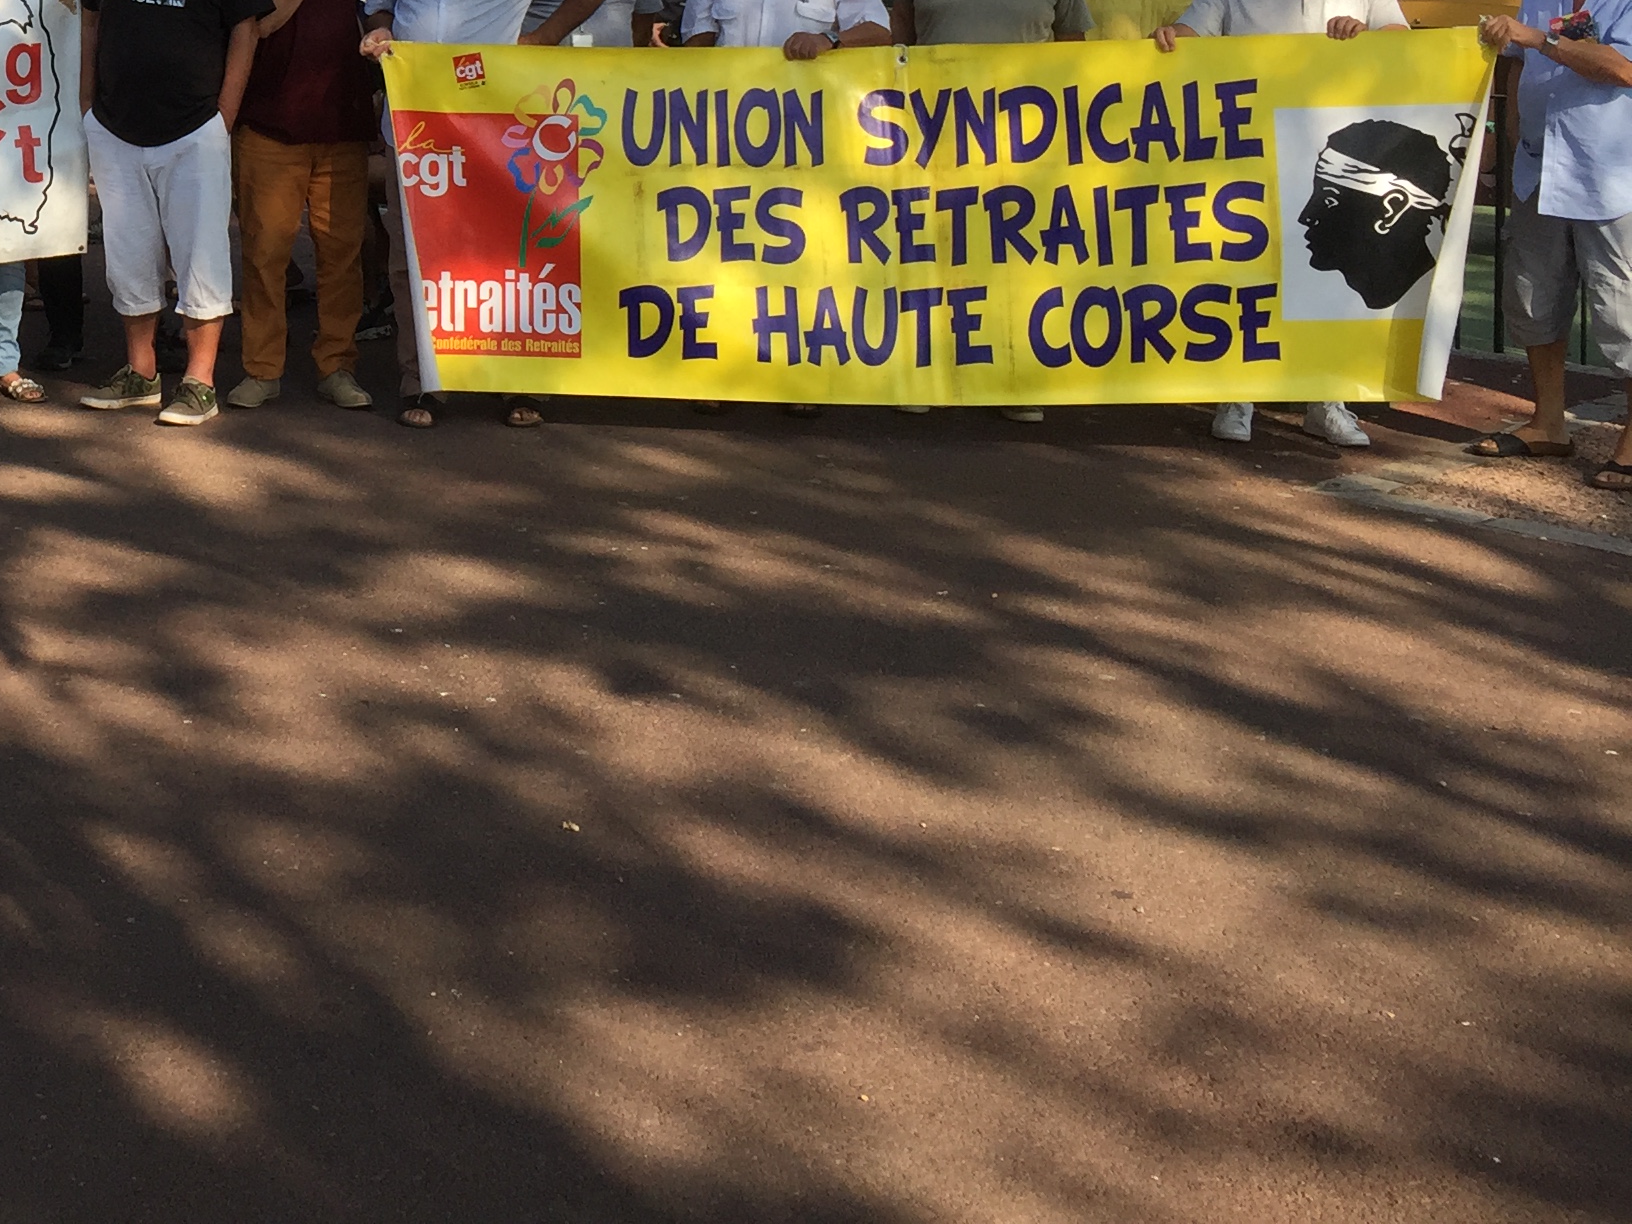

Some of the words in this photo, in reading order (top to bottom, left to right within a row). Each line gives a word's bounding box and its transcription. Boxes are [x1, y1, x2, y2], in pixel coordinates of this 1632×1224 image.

[456, 60, 483, 80] cgt
[398, 120, 453, 153] la
[621, 87, 825, 168] UNION
[856, 78, 1264, 170] SYNDICALE
[399, 145, 467, 197] cgt
[657, 184, 806, 265] DES
[839, 180, 1269, 267] RETRAITES
[421, 263, 582, 335] etraités
[619, 284, 718, 361] DE
[752, 284, 994, 368] HAUTE
[1028, 282, 1282, 368] CORSE
[501, 338, 522, 352] des
[525, 338, 580, 354] Retraités
